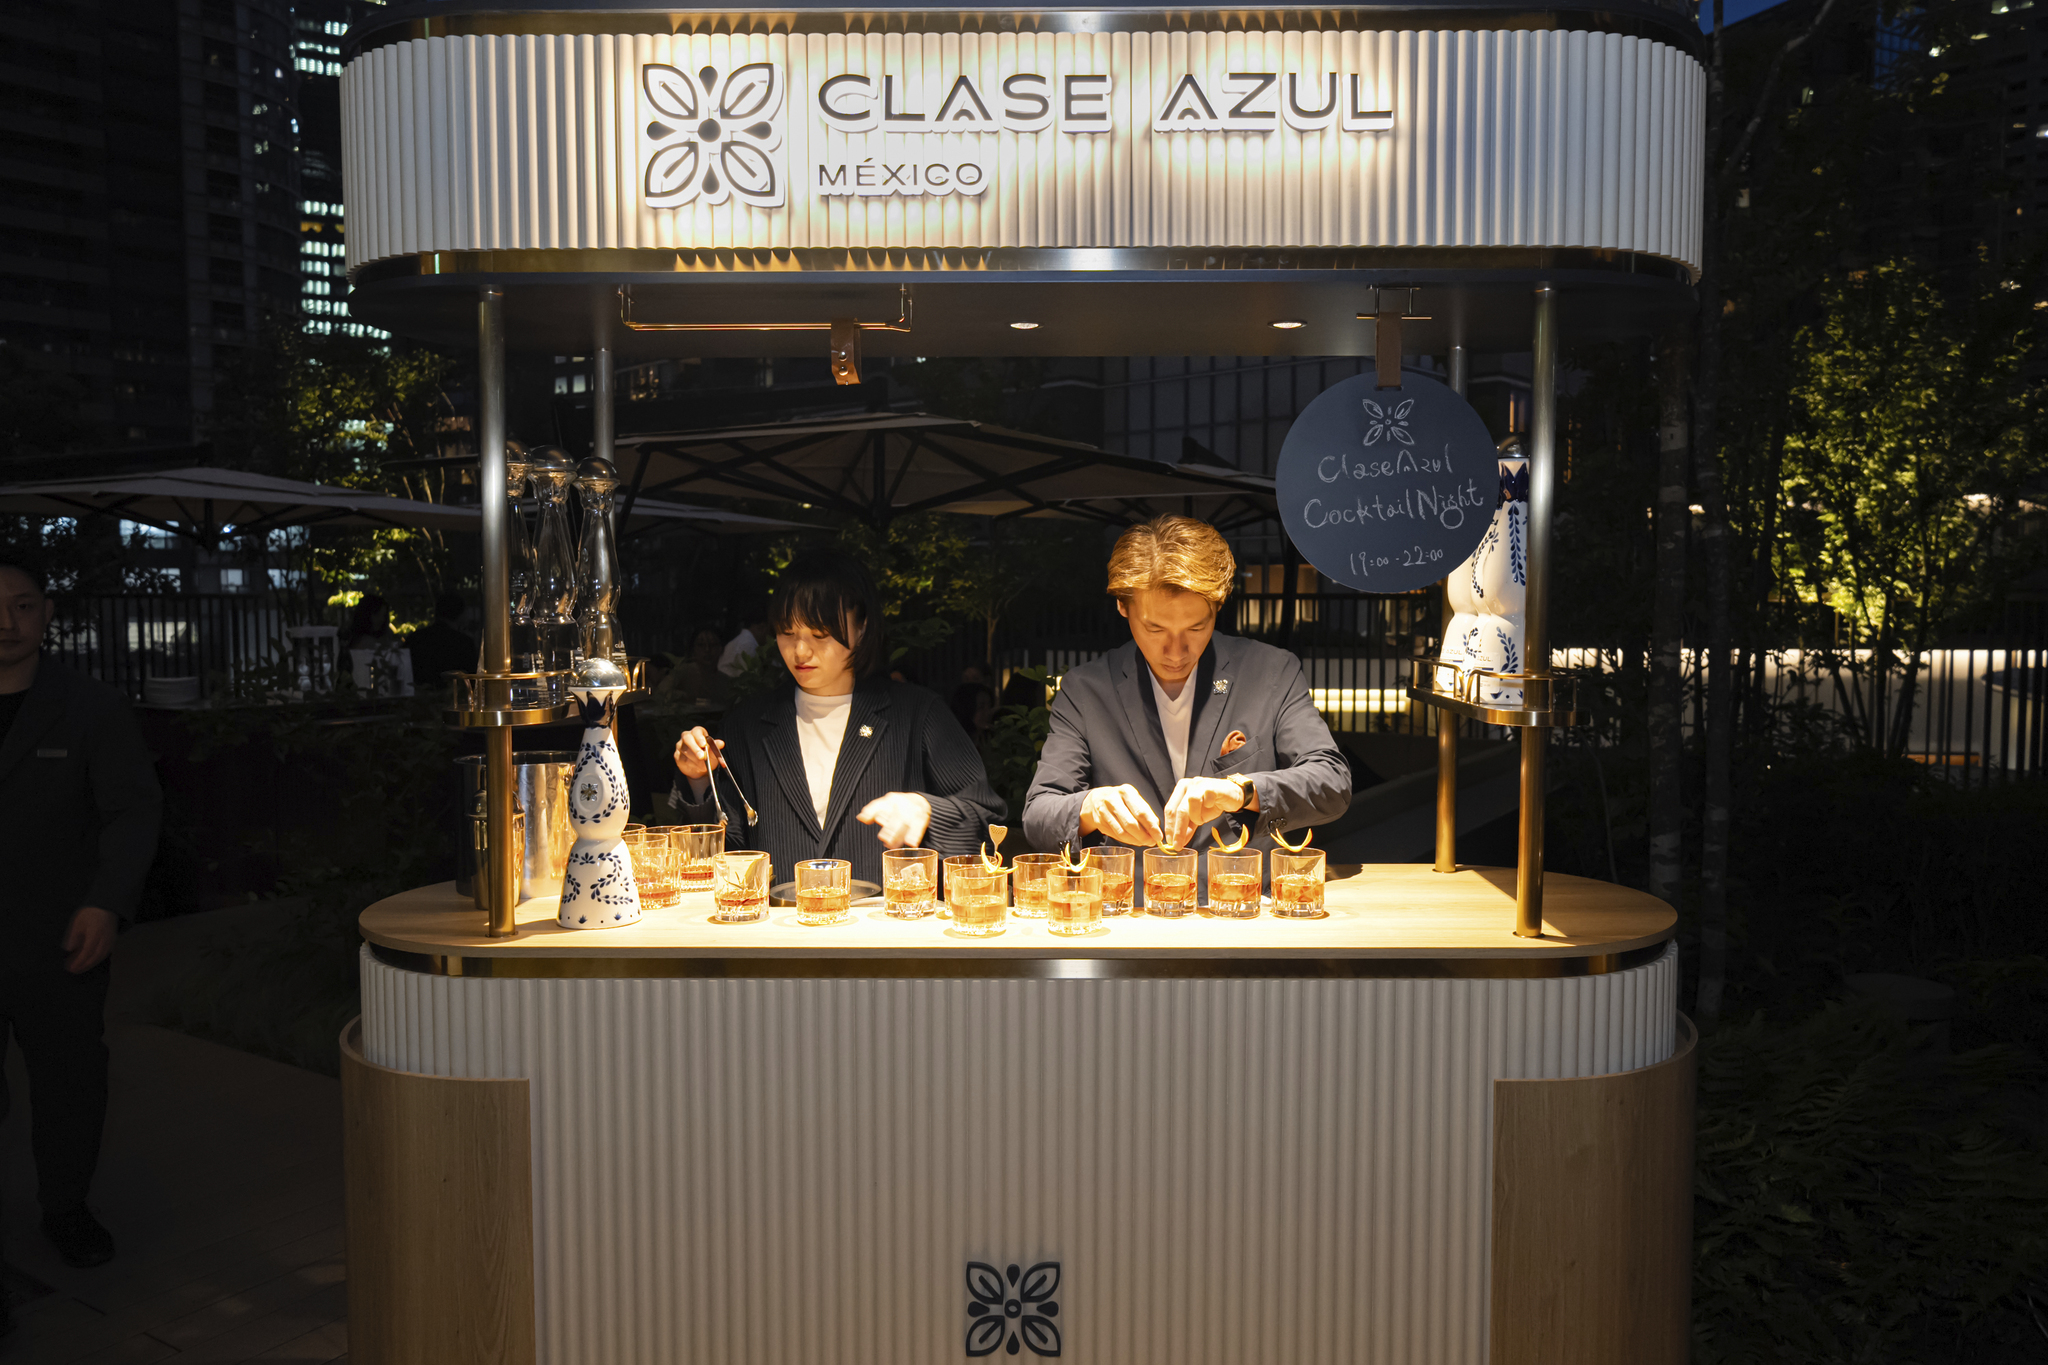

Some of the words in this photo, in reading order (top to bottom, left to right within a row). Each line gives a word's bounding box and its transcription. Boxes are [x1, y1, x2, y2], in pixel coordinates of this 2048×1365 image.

[818, 73, 1108, 122] CLASE
[1159, 71, 1393, 120] AZUL
[818, 157, 983, 187] MÉXICO
